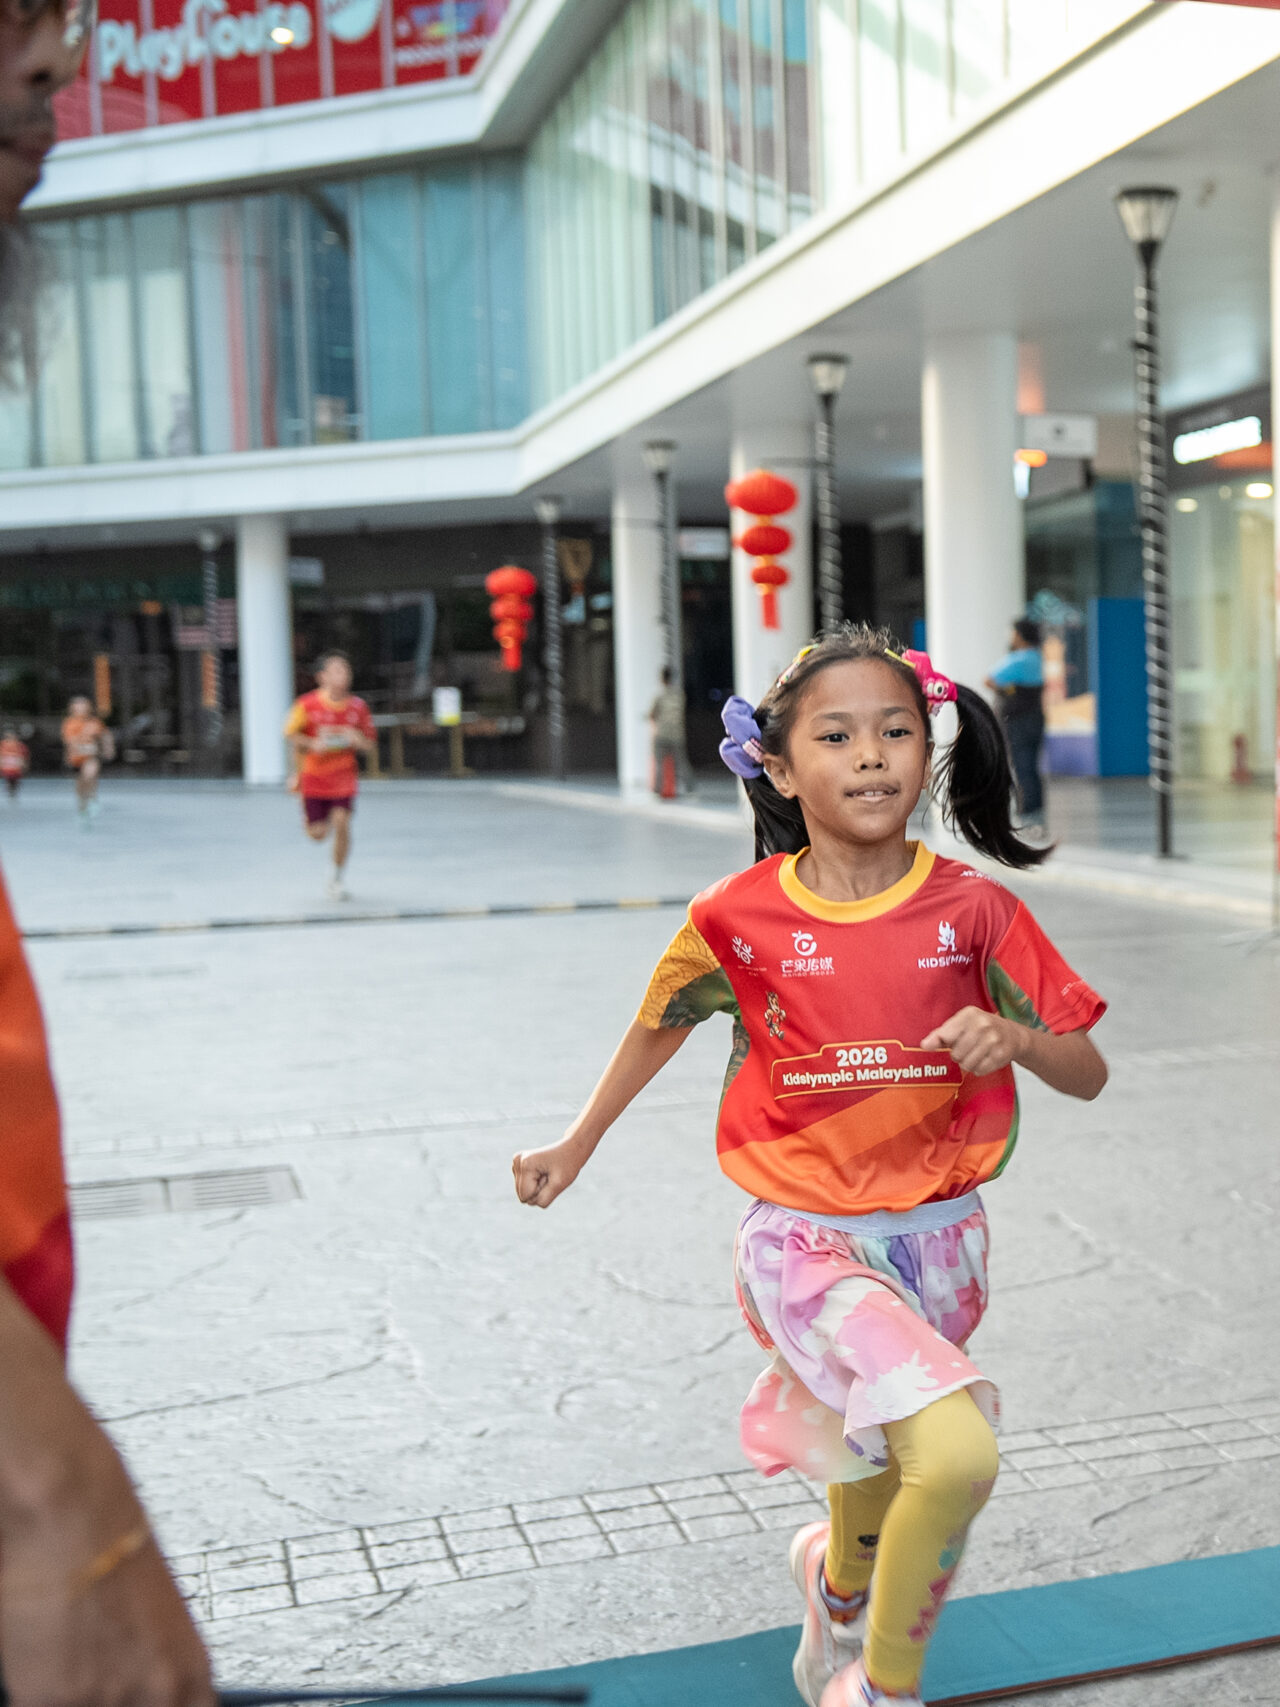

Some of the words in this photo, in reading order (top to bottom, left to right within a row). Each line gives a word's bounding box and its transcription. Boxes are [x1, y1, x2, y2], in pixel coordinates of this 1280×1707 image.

[780, 956, 835, 973] 芒果传媒
[836, 1046, 888, 1067] 2026
[782, 1069, 854, 1088] Kidslympic
[856, 1065, 923, 1082] Malaysia
[924, 1065, 948, 1077] Run
